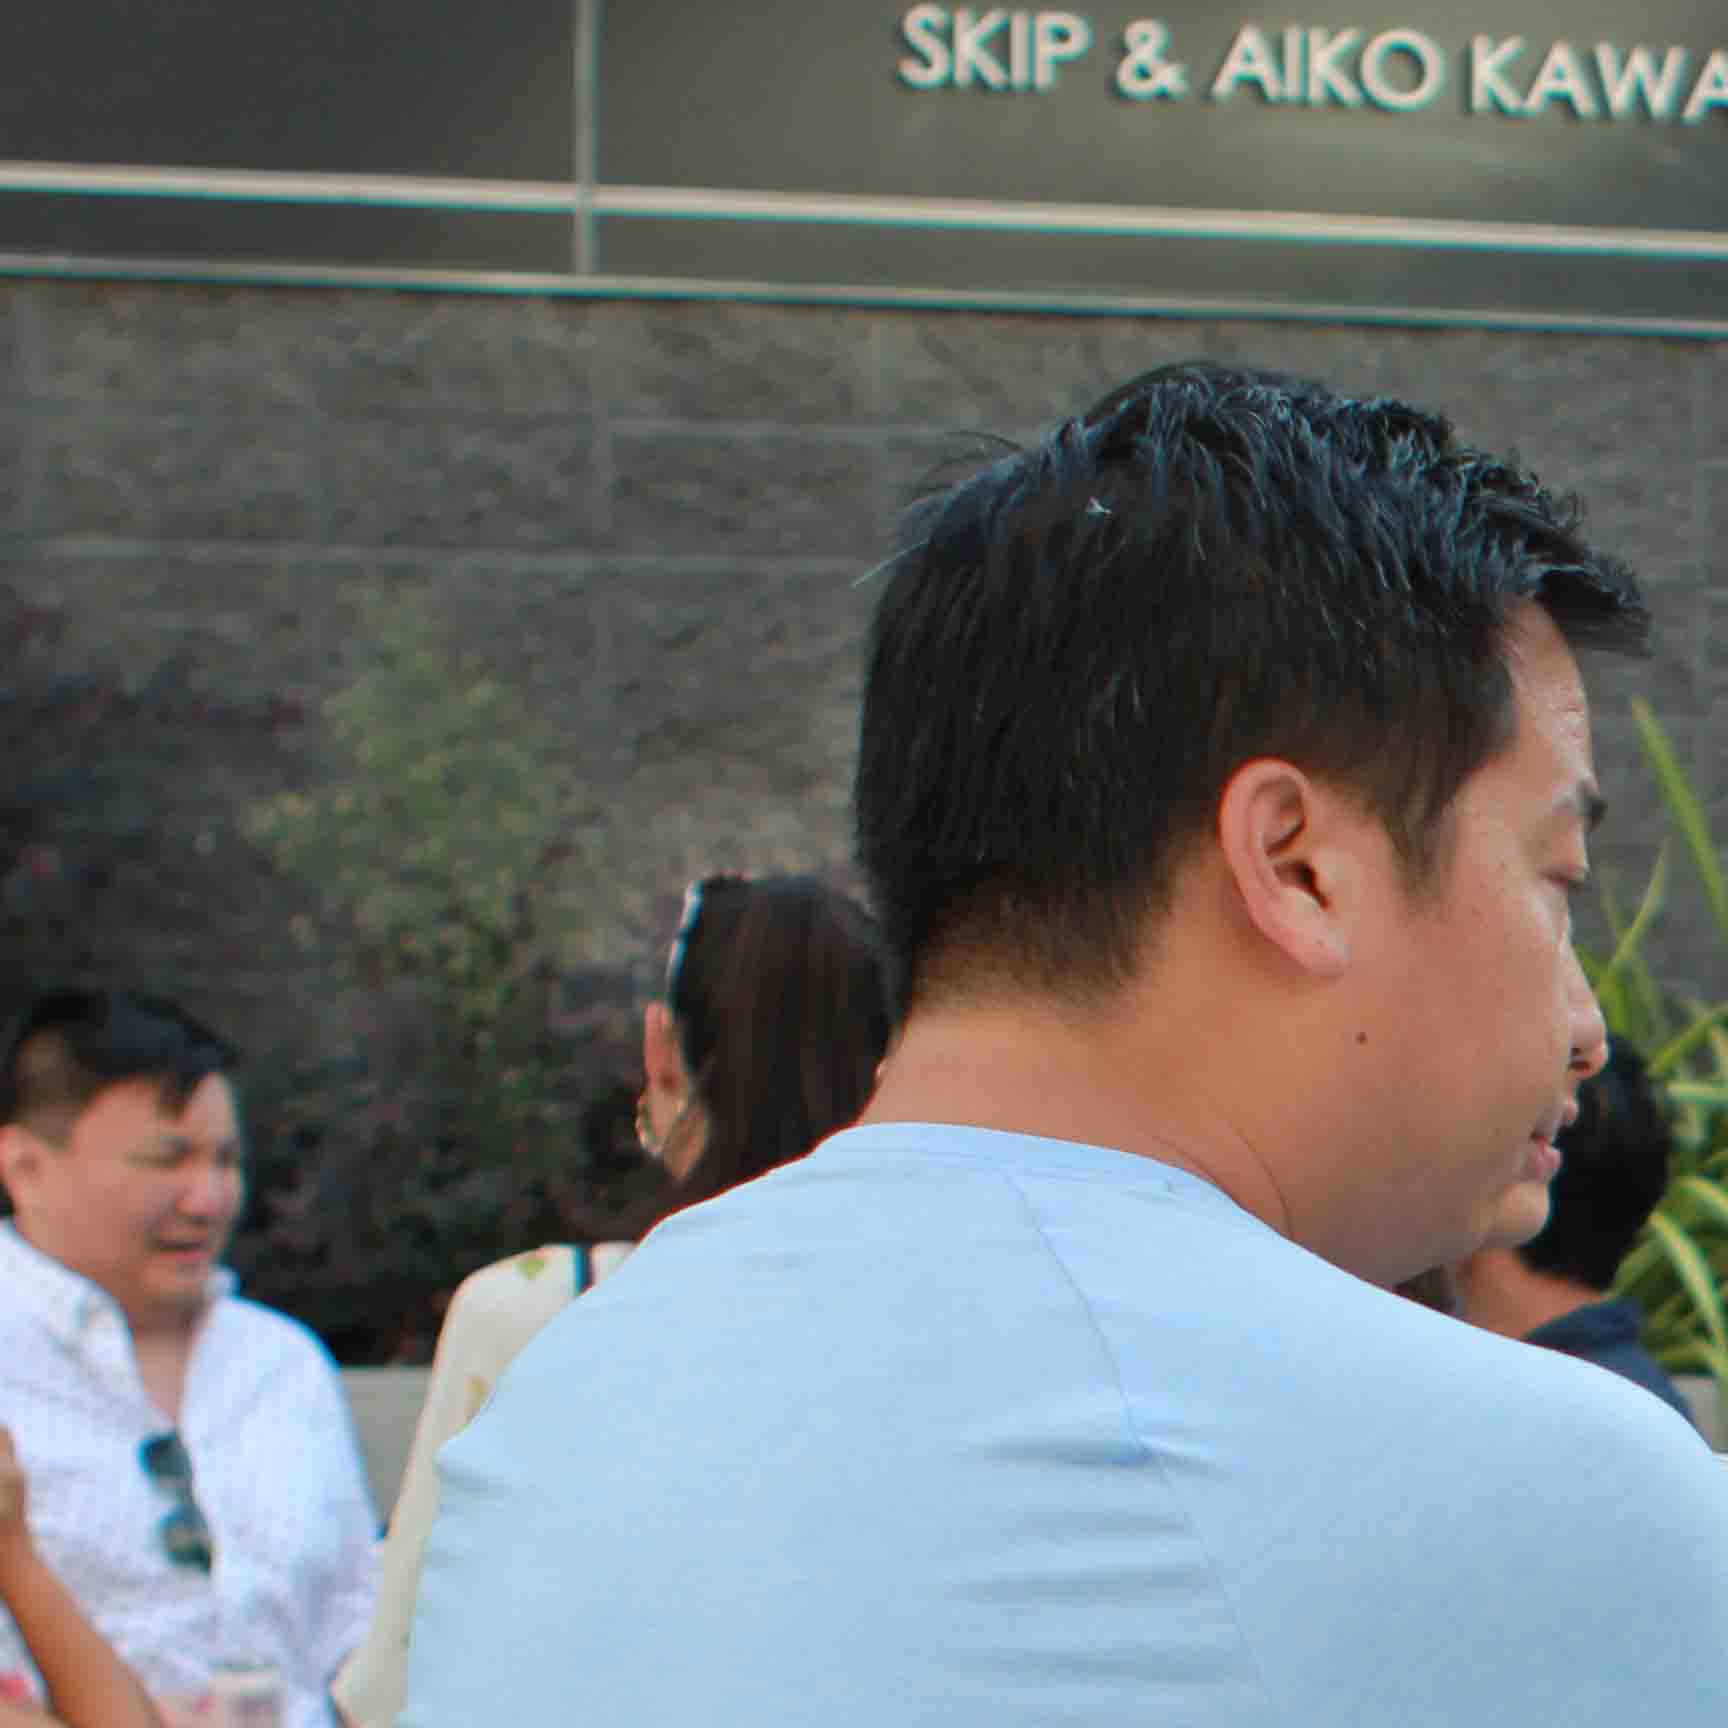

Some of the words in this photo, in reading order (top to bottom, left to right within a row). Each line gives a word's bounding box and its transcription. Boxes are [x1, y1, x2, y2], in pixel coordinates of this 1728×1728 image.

[899, 3, 1093, 91] SKIP
[1115, 18, 1190, 99] &
[1211, 23, 1446, 109] AIKO
